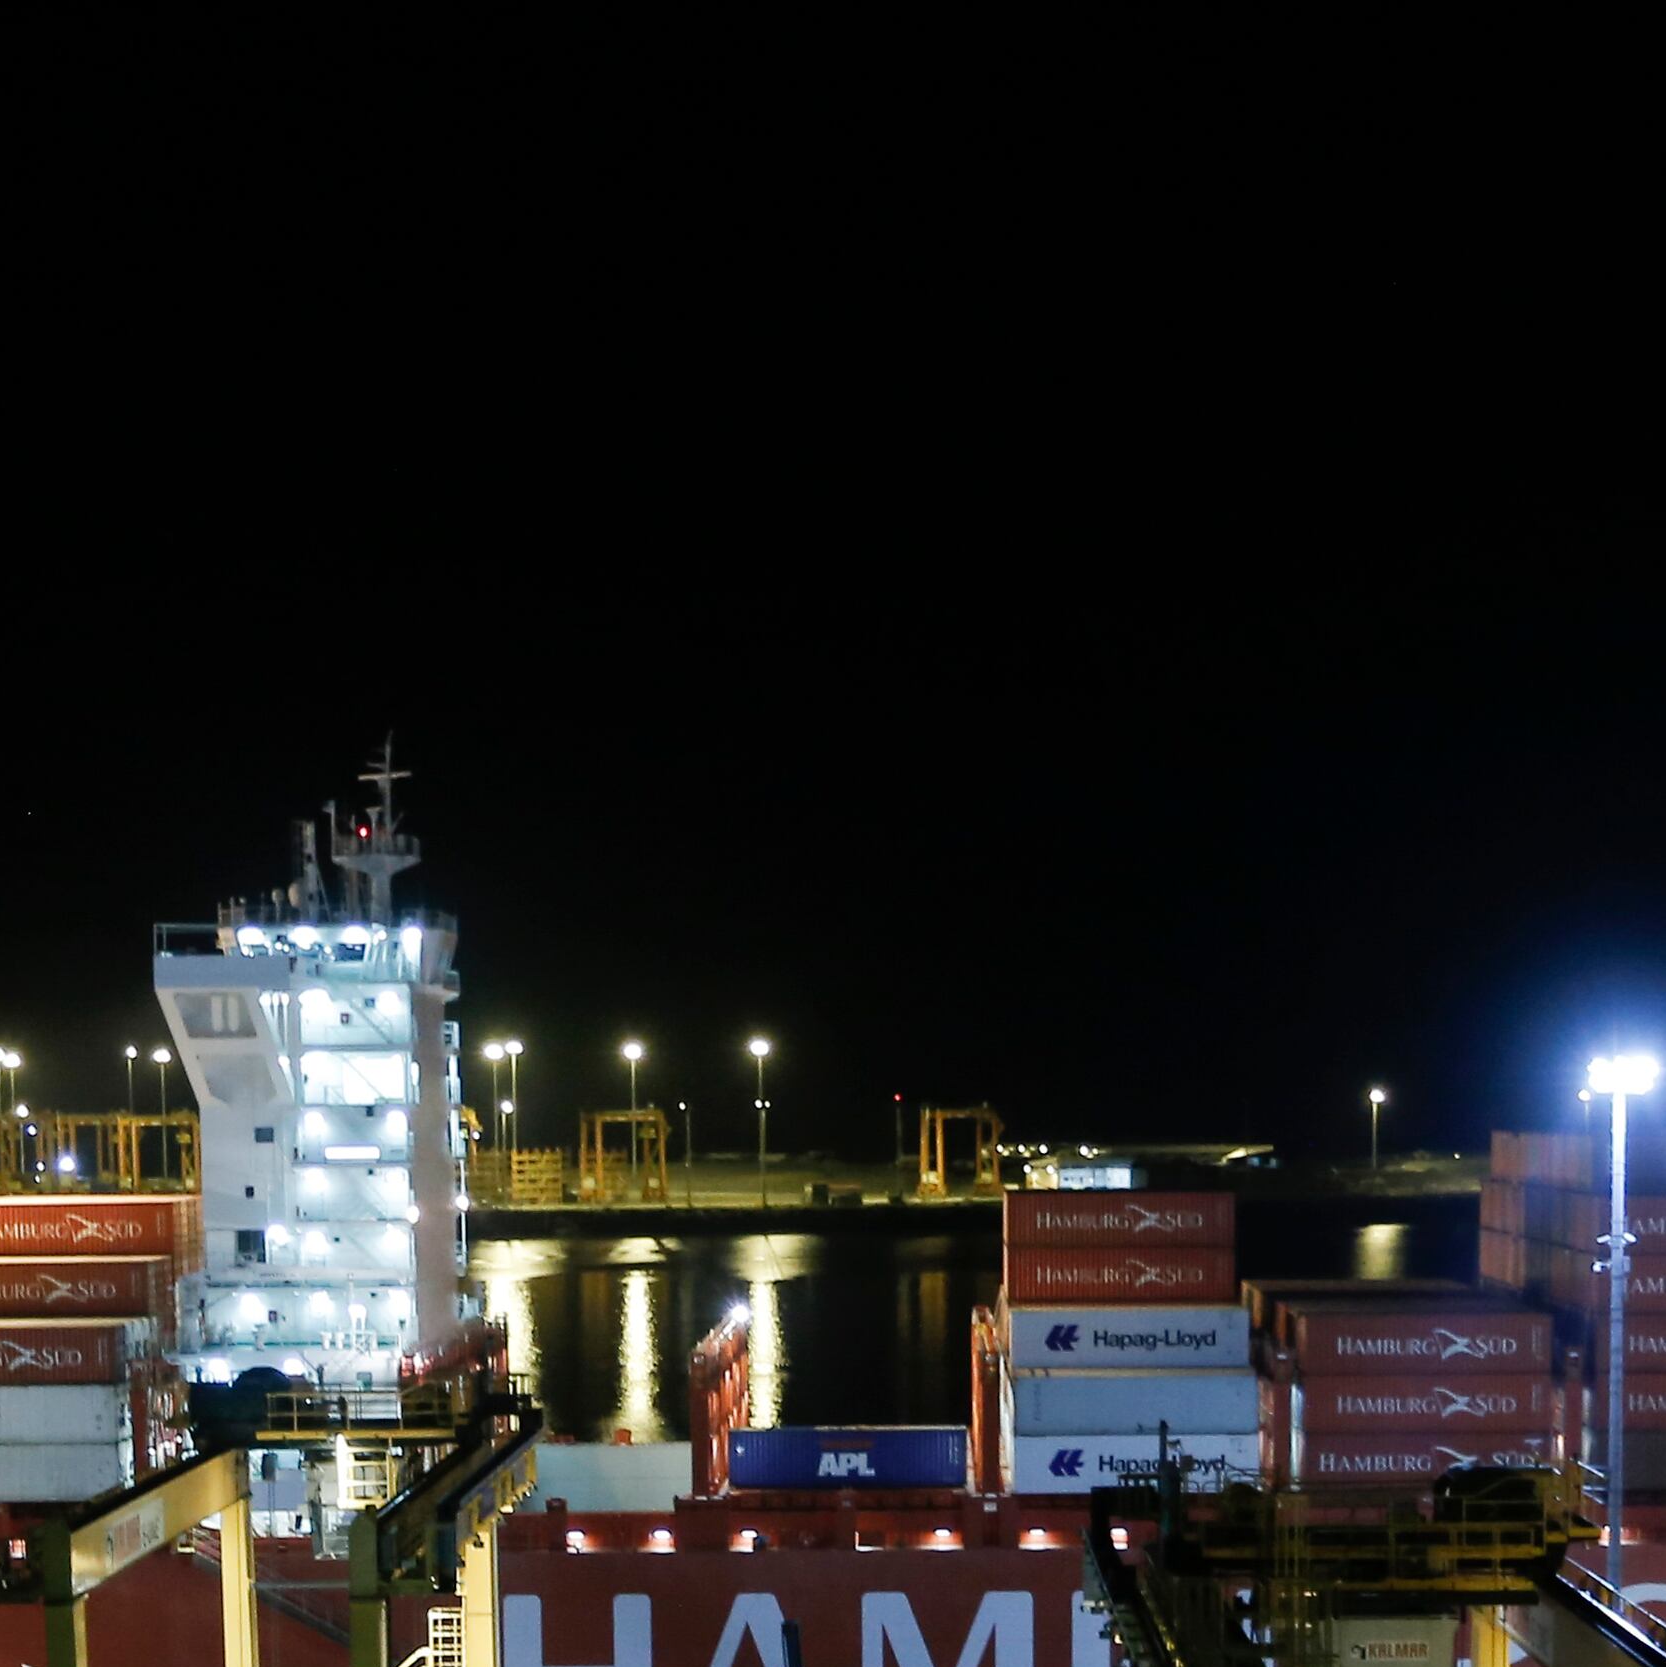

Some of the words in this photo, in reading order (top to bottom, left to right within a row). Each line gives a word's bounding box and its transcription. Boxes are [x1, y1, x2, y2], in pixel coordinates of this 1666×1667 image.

[1036, 1212, 1129, 1230] HAMBURG
[1036, 1266, 1129, 1285] HAMBURG
[1093, 1327, 1216, 1352] Hapag-Lloyd
[1337, 1337, 1436, 1356] HAMBURG
[1337, 1395, 1436, 1416] HAMBURG
[818, 1452, 875, 1476] APL
[1319, 1454, 1431, 1471] HAMBURG
[1369, 1644, 1428, 1658] KALMAR
